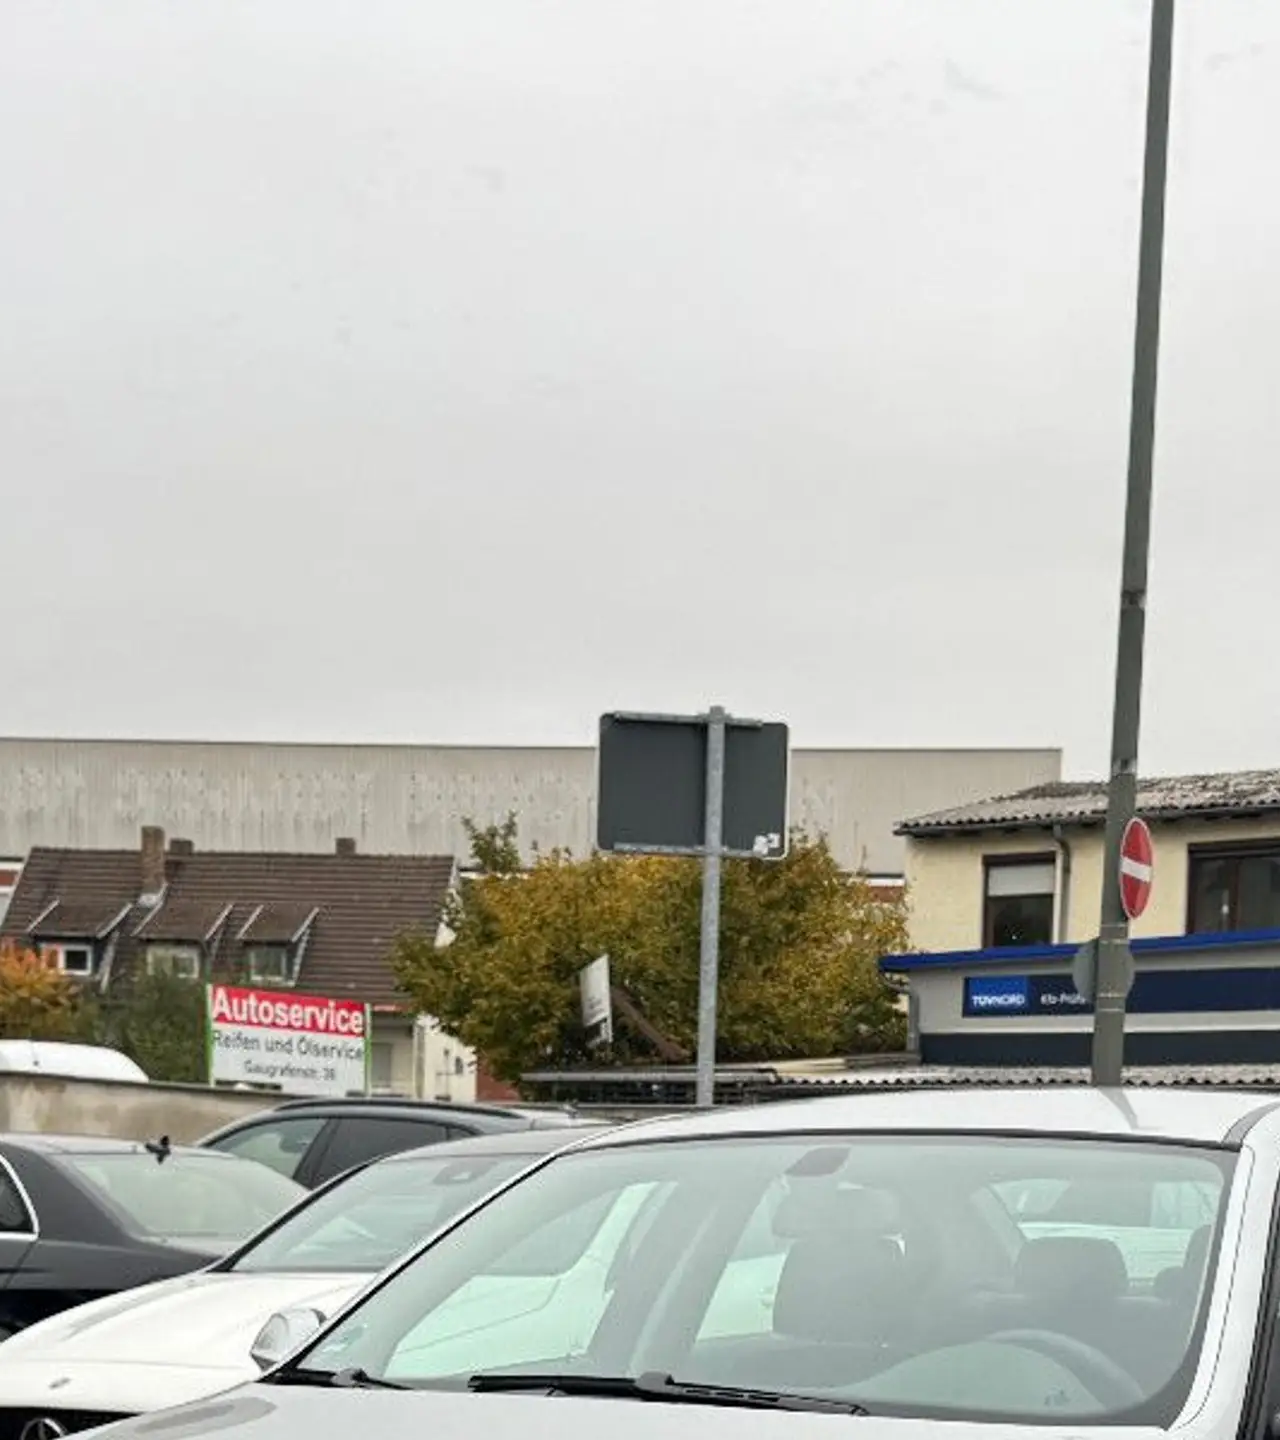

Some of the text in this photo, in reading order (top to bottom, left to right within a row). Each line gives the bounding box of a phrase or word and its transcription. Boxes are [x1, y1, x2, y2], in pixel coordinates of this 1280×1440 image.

[213, 986, 364, 1034] Autoservice
[213, 1030, 260, 1051] Reifen
[265, 1036, 293, 1055] und
